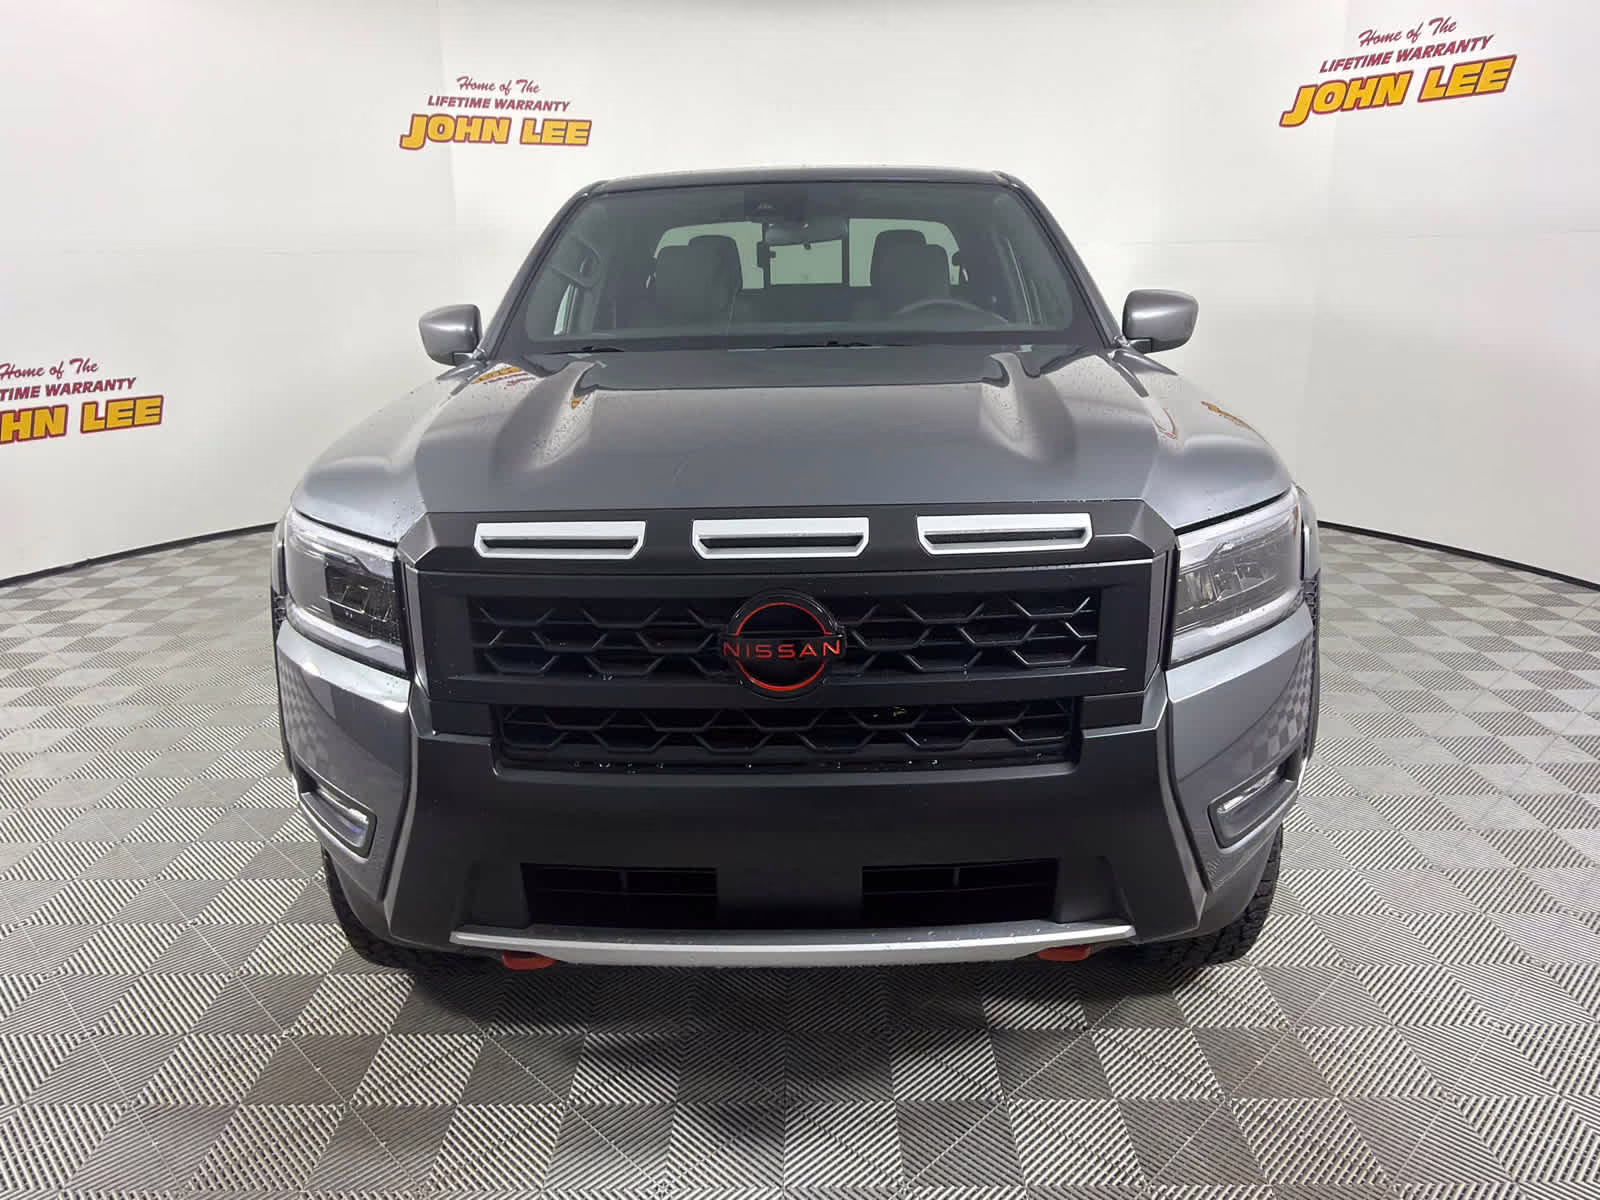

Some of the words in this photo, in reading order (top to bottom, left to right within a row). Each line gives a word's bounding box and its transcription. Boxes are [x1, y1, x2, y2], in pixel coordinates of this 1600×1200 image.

[1358, 29, 1402, 47] Home
[1406, 23, 1424, 43] of
[1428, 16, 1457, 36] The
[1319, 50, 1394, 74] LIFETIME
[1396, 34, 1494, 63] WARRANTY
[456, 76, 496, 91] Home
[499, 79, 513, 96] of
[515, 79, 541, 94] The
[1279, 70, 1414, 127] JOHN
[1417, 54, 1517, 103] LEE
[427, 95, 491, 109] LIFETIME
[494, 98, 571, 112] WARRANTY
[399, 113, 512, 151] JOHN
[519, 117, 592, 147] LEE
[0, 363, 45, 380] Home
[49, 361, 65, 379] of
[69, 358, 99, 374] The
[45, 376, 137, 397] WARRANTY
[80, 394, 164, 434] LEE
[722, 639, 841, 660] NISSAN
